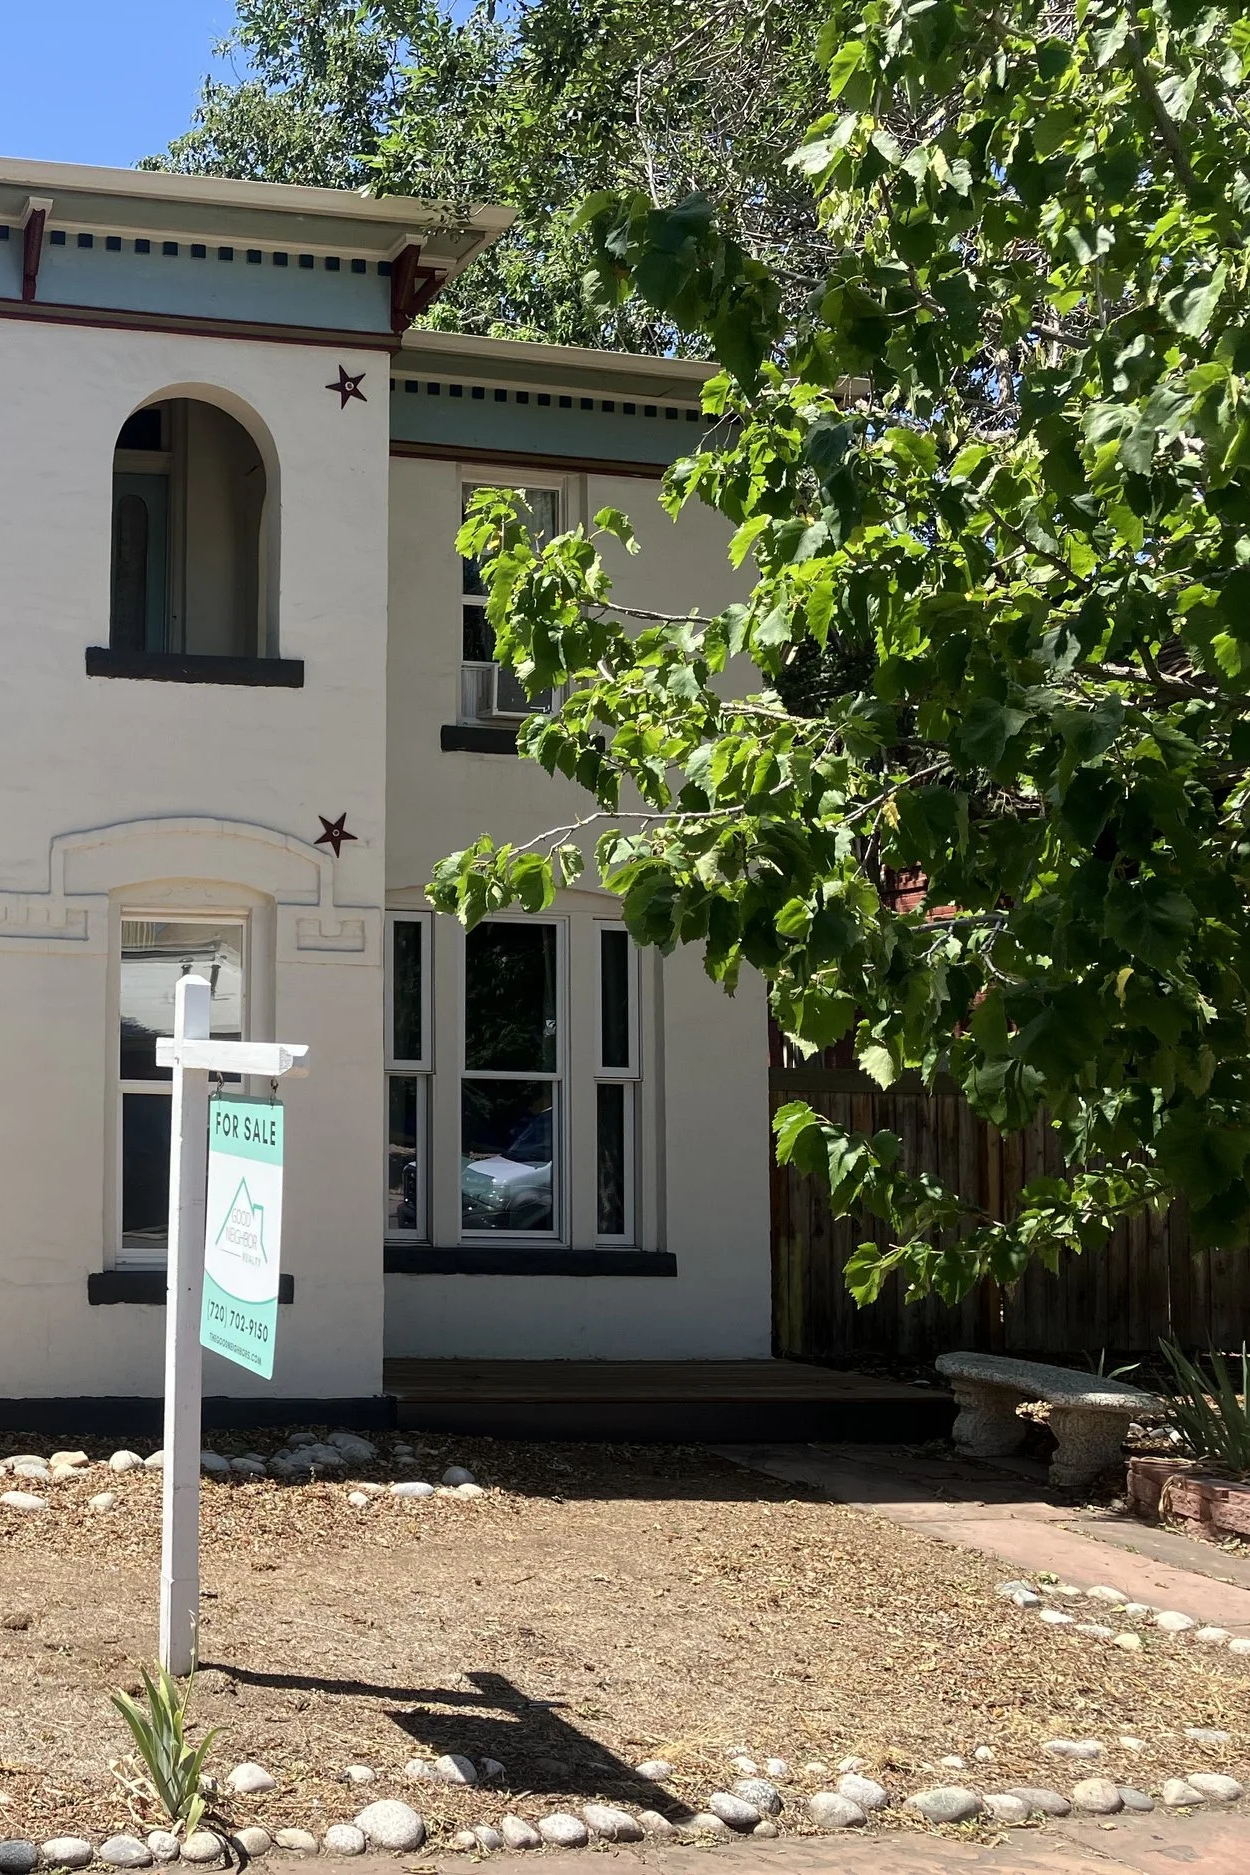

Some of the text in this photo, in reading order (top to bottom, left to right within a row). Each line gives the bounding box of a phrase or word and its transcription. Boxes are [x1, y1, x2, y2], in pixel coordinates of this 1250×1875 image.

[216, 1111, 276, 1146] FOR SALE
[231, 1207, 252, 1228] GOOD
[225, 1226, 258, 1250] NEIGHBOR
[242, 1252, 262, 1269] REALTY
[207, 1298, 269, 1343] (720) 702-9150
